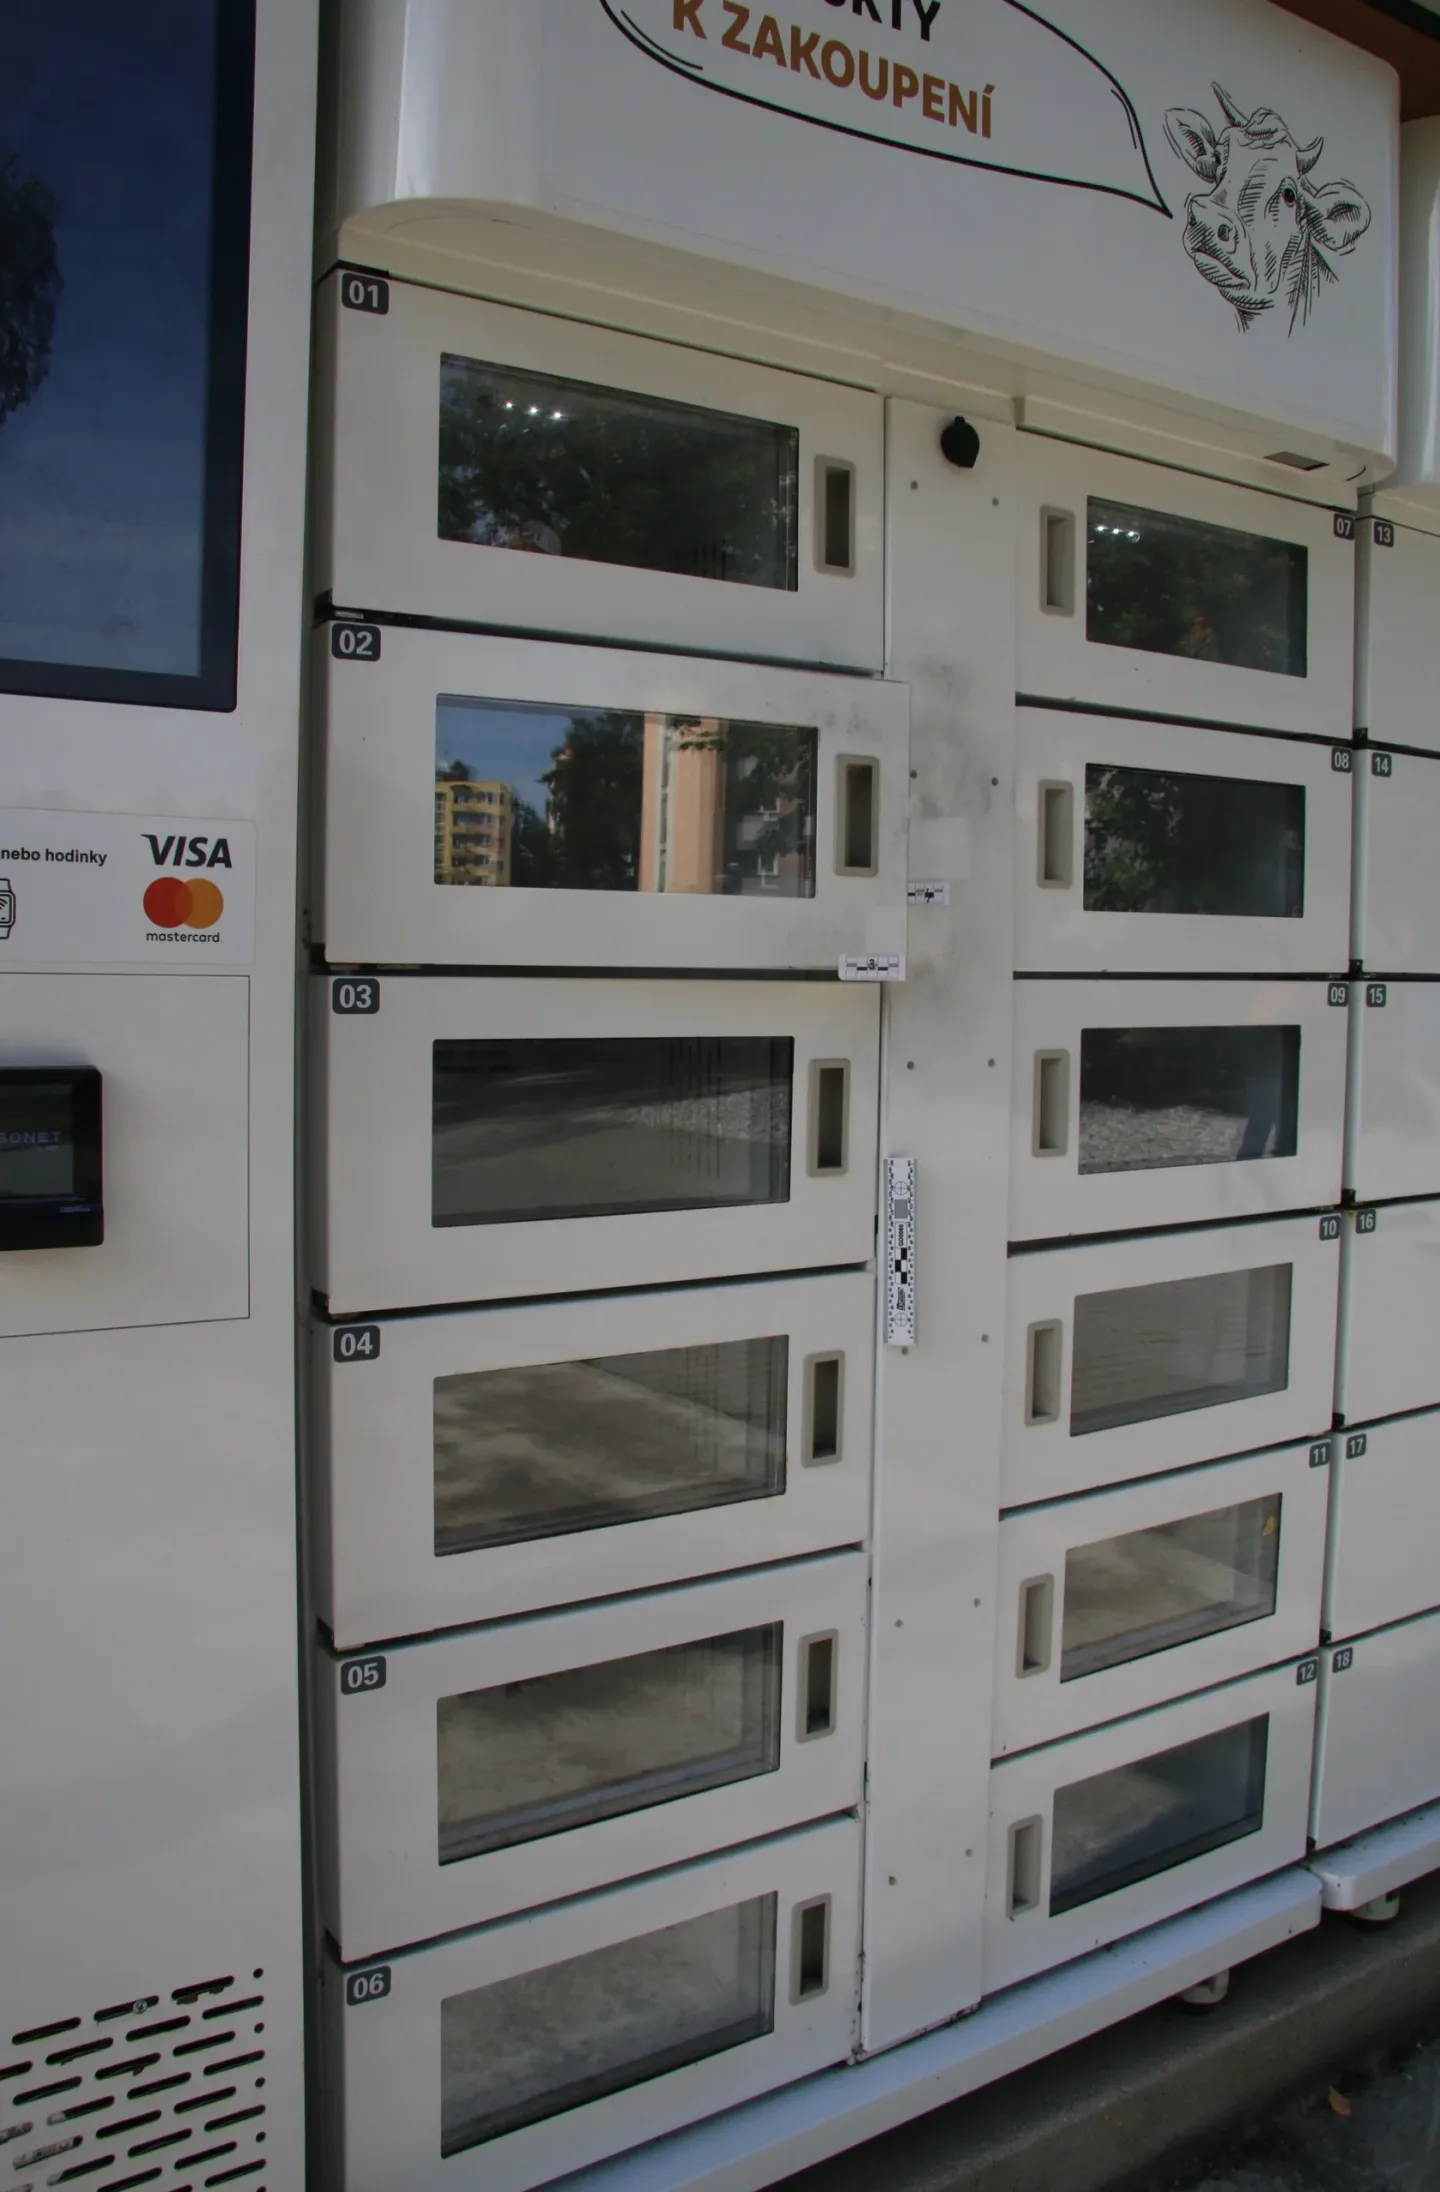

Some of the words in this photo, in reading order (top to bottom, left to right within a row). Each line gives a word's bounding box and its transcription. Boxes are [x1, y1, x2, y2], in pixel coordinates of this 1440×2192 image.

[673, 0, 707, 40] K
[721, 0, 996, 139] ZAKOUPENÍ
[349, 280, 378, 308] 01
[1336, 518, 1351, 535] 07
[1377, 525, 1391, 543] 13
[339, 630, 373, 655] 02
[1334, 751, 1349, 769] 08
[1376, 757, 1389, 773] 14
[0, 848, 41, 861] nebo
[45, 848, 107, 866] hodinky
[140, 834, 232, 868] VISA
[146, 931, 220, 943] mastercard
[339, 984, 371, 1009] 03
[1330, 986, 1346, 1003] 09
[1370, 987, 1383, 1004] 15
[1322, 1219, 1337, 1237] 10
[1360, 1212, 1373, 1230] 16
[340, 1331, 373, 1356] 04
[1313, 1446, 1326, 1464] 11
[1350, 1438, 1363, 1455] 17
[1336, 1651, 1350, 1669] 18
[348, 1662, 379, 1688] 05
[1300, 1662, 1314, 1681] 12
[353, 1972, 384, 1998] 06
